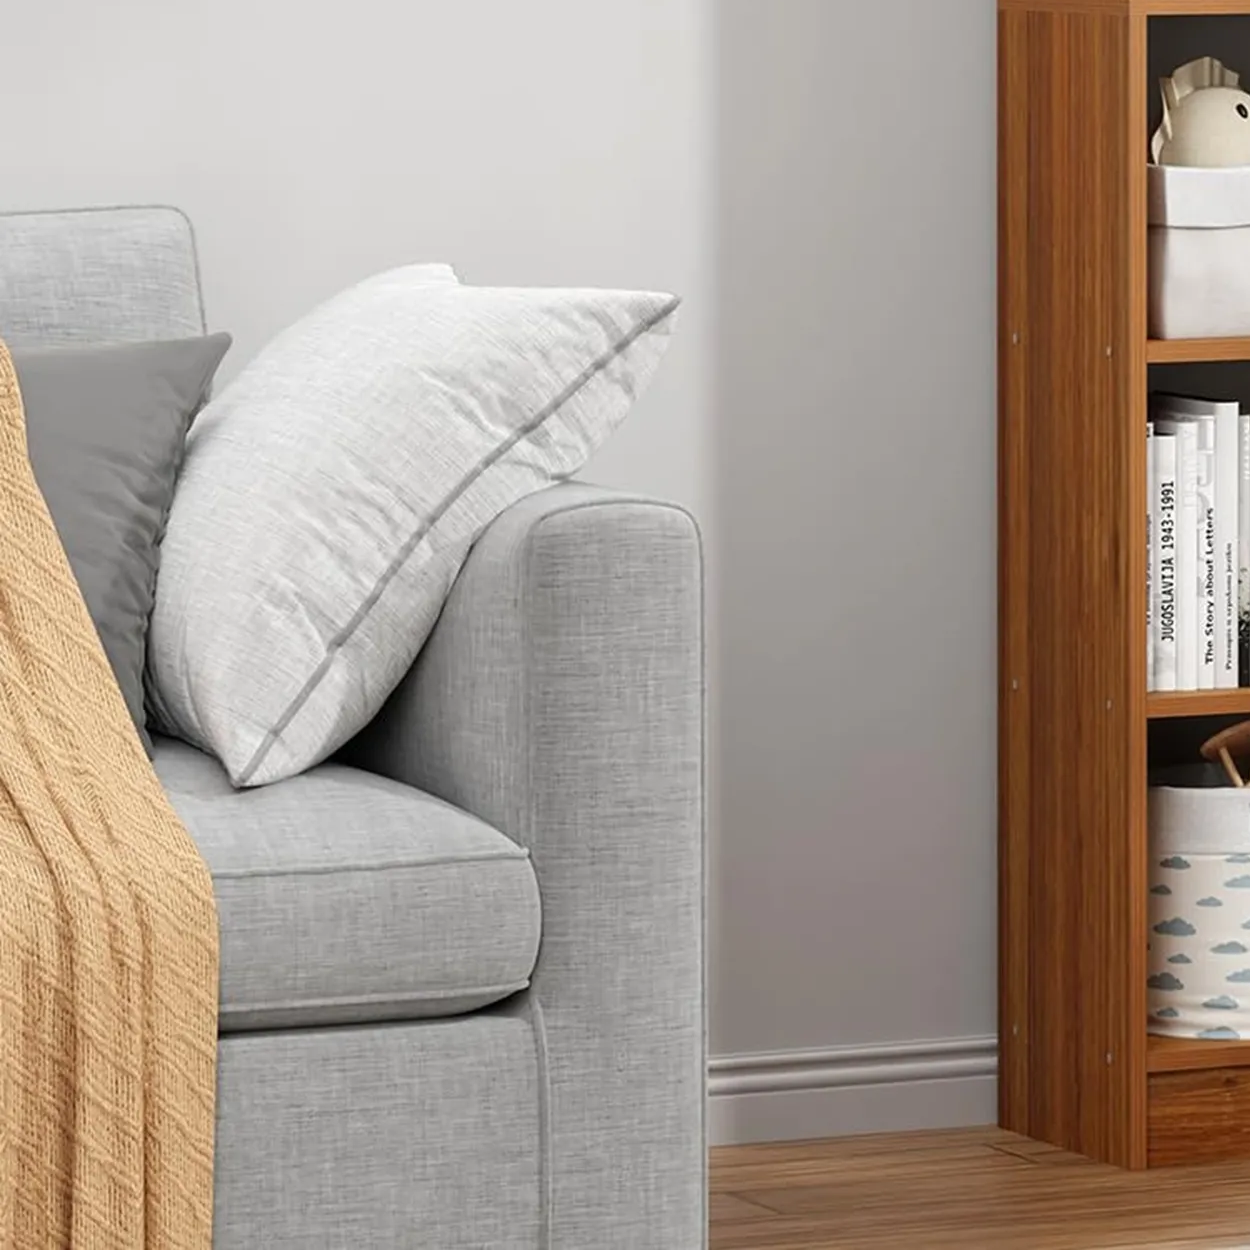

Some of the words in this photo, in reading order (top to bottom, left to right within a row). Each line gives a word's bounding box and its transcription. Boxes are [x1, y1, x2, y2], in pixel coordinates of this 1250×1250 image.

[1162, 481, 1174, 550] 1943-1991
[1205, 508, 1214, 555] Letters
[1205, 559, 1214, 597] about
[1162, 557, 1174, 642] JUGOSLAVIJA
[1205, 601, 1215, 636] Story
[1205, 640, 1214, 664] The
